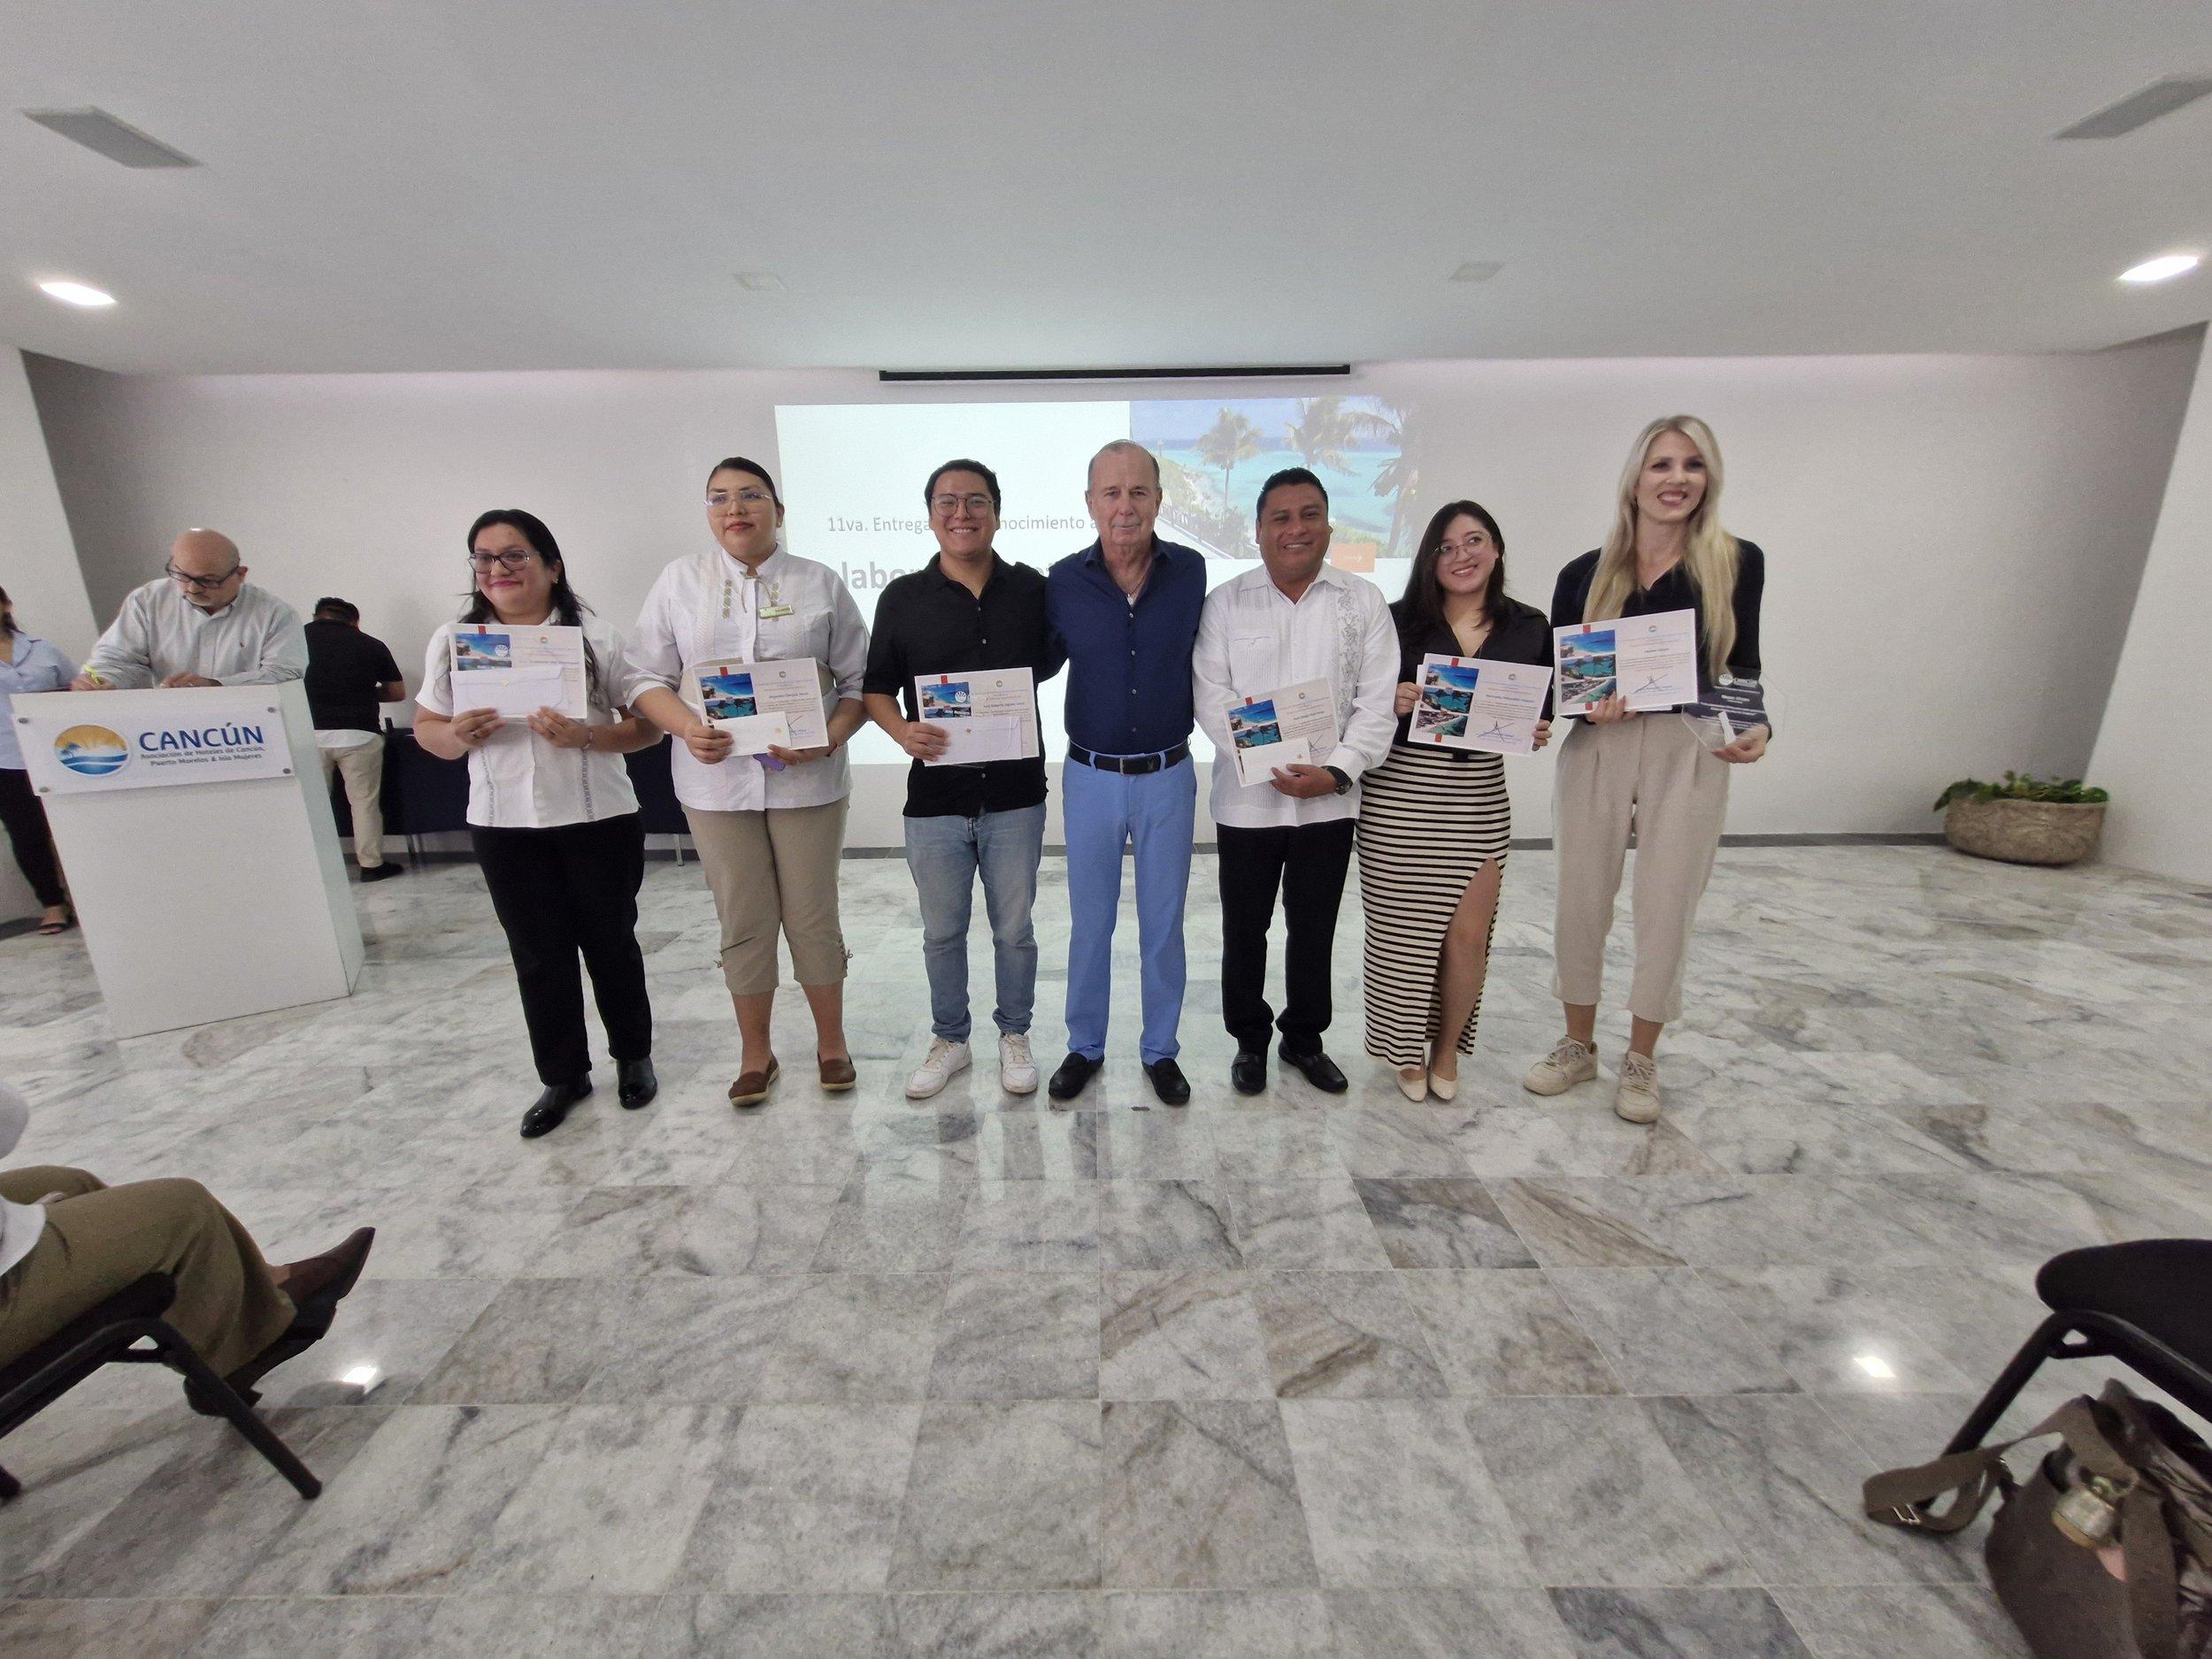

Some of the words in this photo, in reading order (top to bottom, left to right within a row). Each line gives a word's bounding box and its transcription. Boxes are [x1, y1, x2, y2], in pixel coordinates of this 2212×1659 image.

[828, 517, 868, 532] 11va.
[873, 517, 930, 534] Entrega
[139, 722, 265, 751] CANCÚN
